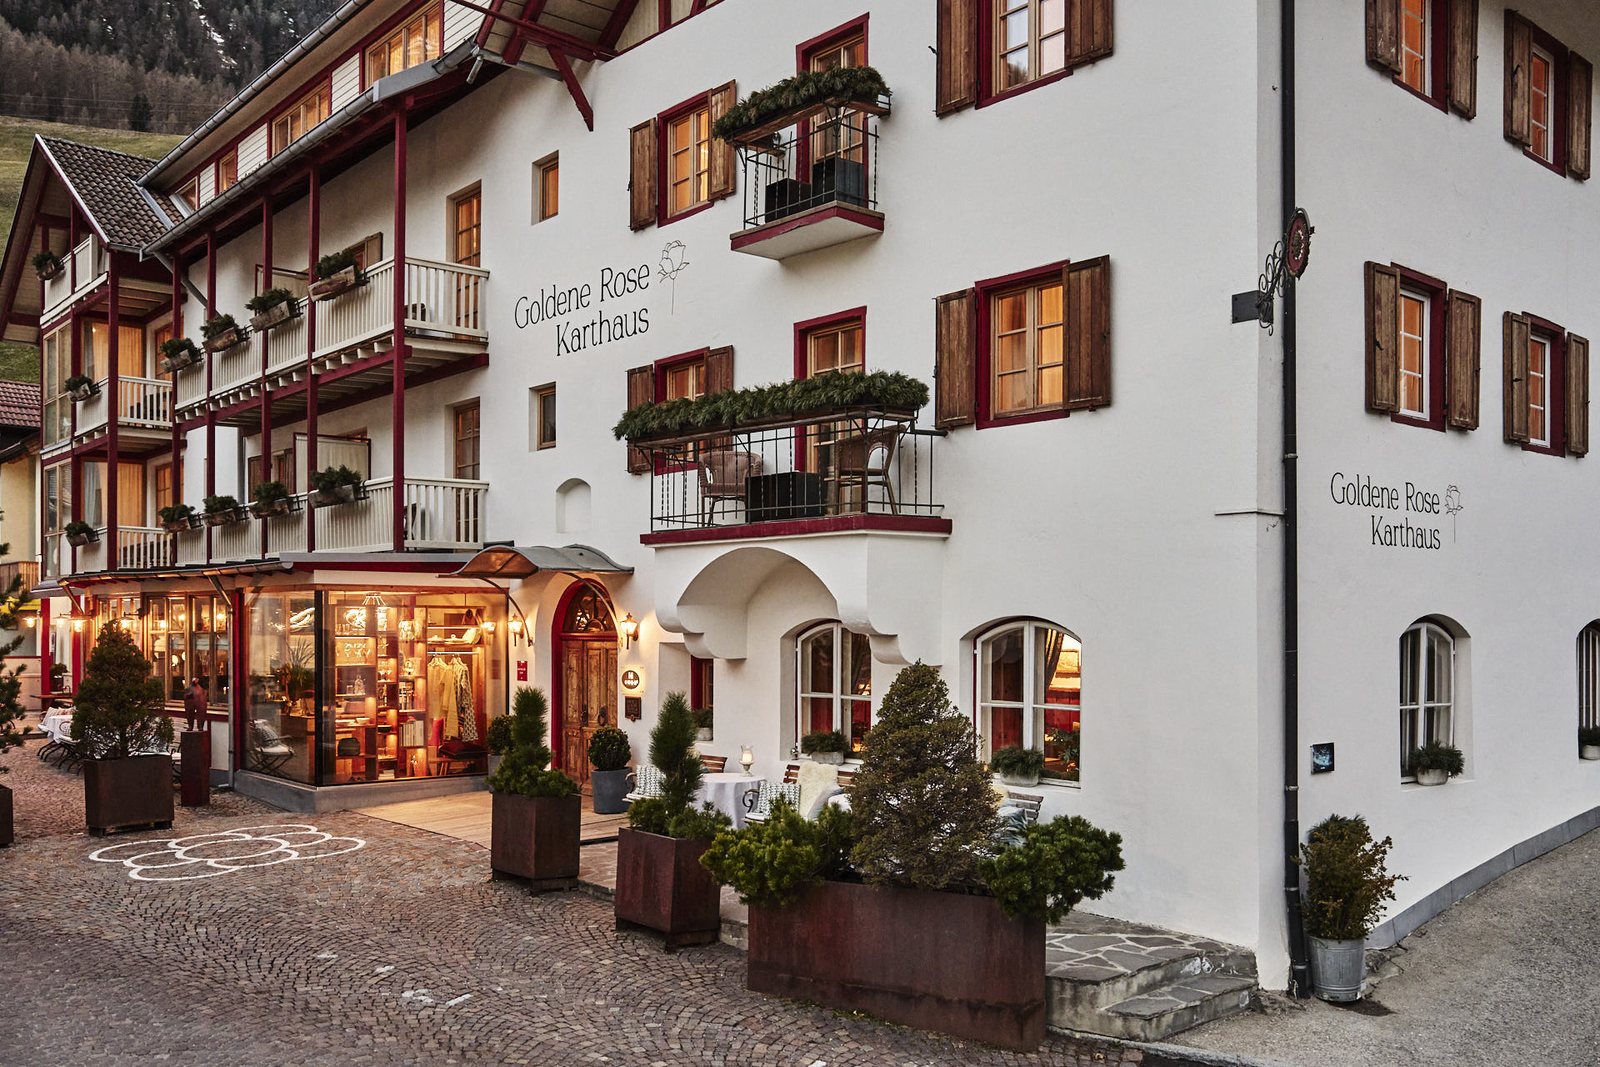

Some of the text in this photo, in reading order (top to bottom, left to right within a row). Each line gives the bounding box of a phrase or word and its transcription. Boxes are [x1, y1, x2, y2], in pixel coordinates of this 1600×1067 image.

[515, 264, 650, 329] Goldene Rose
[556, 308, 649, 356] Karthaus
[1330, 472, 1440, 514] Goldene Rose
[1371, 515, 1441, 550] Karthaus
